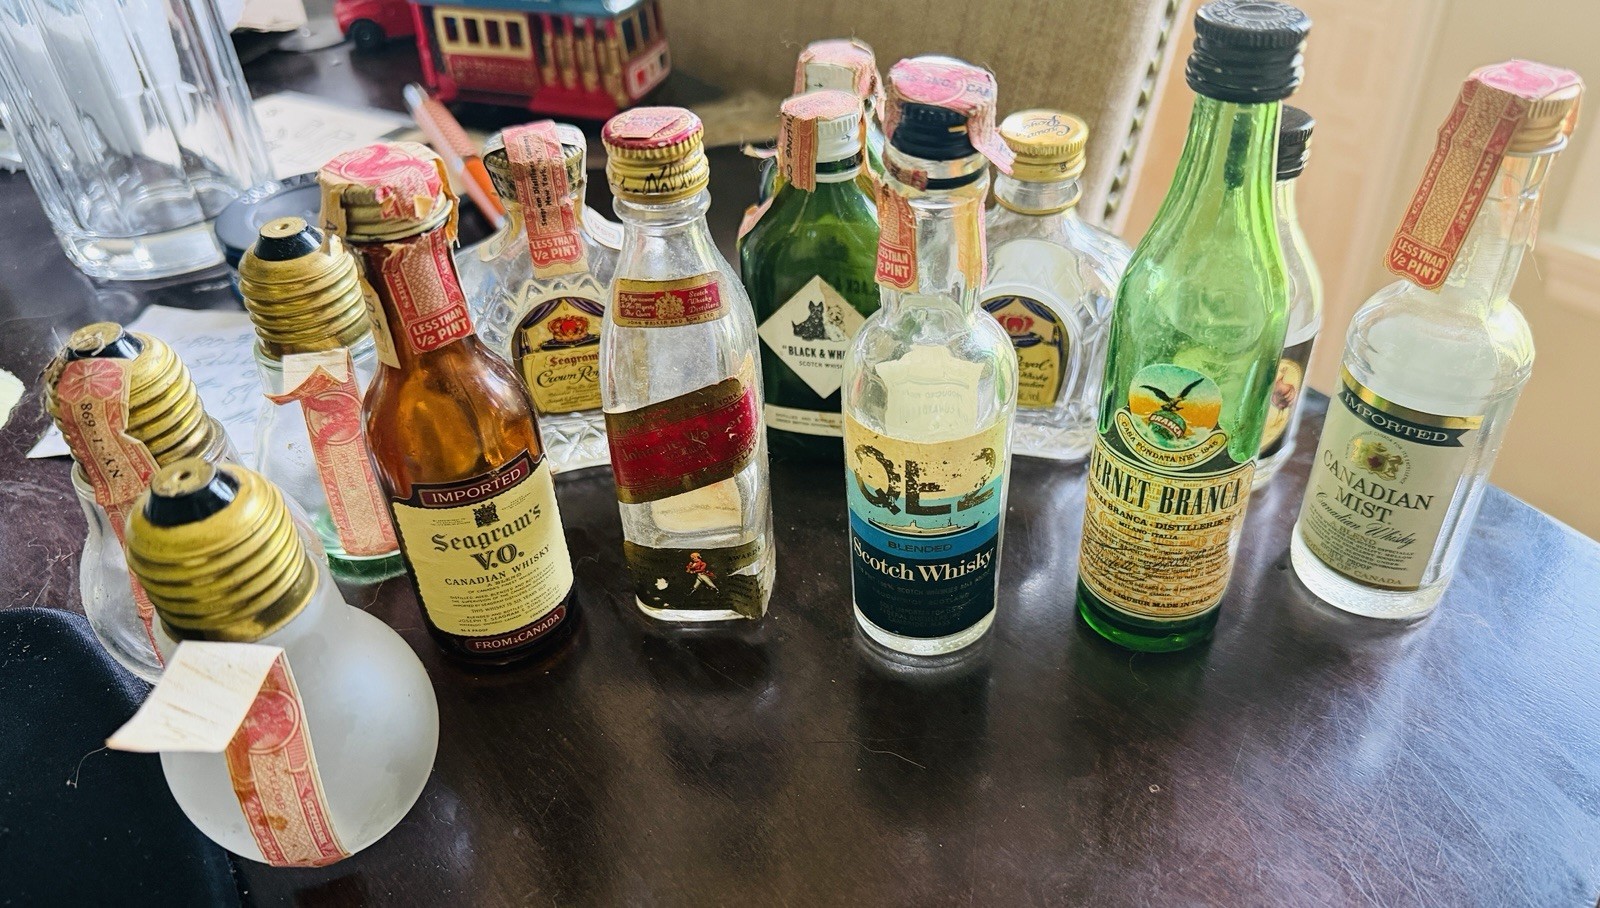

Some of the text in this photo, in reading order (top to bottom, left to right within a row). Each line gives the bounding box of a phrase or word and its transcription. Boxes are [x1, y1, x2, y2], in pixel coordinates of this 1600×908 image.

[545, 191, 553, 205] New
[531, 237, 575, 250] LESS THAN
[552, 246, 577, 259] PINT
[1397, 238, 1446, 269] LESS THAN
[888, 250, 908, 265] THAN
[884, 263, 909, 278] PINT
[1407, 260, 1441, 281] PINT
[412, 308, 464, 336] LESS THAN
[439, 318, 469, 340] PINT
[549, 352, 599, 367] Seagram'
[819, 349, 826, 358] &
[827, 349, 846, 360] WHI
[537, 370, 576, 388] Crown
[718, 393, 738, 405] YORK
[1150, 413, 1182, 439] BRANCA
[1345, 392, 1449, 442] IMPORTED
[1135, 442, 1177, 463] FONDATA
[432, 468, 521, 503] IMPORTED
[854, 444, 996, 516] QE2
[1323, 449, 1434, 510] CANADIAN
[1158, 479, 1240, 515] BRANCA
[431, 504, 541, 552] Seagram's
[1107, 504, 1147, 526] BRANCA
[1155, 518, 1224, 531] DISTILLERIE
[1316, 491, 1361, 531] Canadian
[1364, 521, 1417, 550] Whisky
[1338, 524, 1377, 546] BLEND
[470, 543, 525, 571] V.O.
[887, 540, 953, 554] BLENDED
[445, 544, 550, 586] CANADIAN WHISKY
[853, 536, 915, 582] Scotch
[916, 547, 995, 582] Whisky
[1354, 570, 1401, 585] CANADA
[490, 610, 520, 621] SEAGRAM
[475, 613, 560, 650] FROM CANADA
